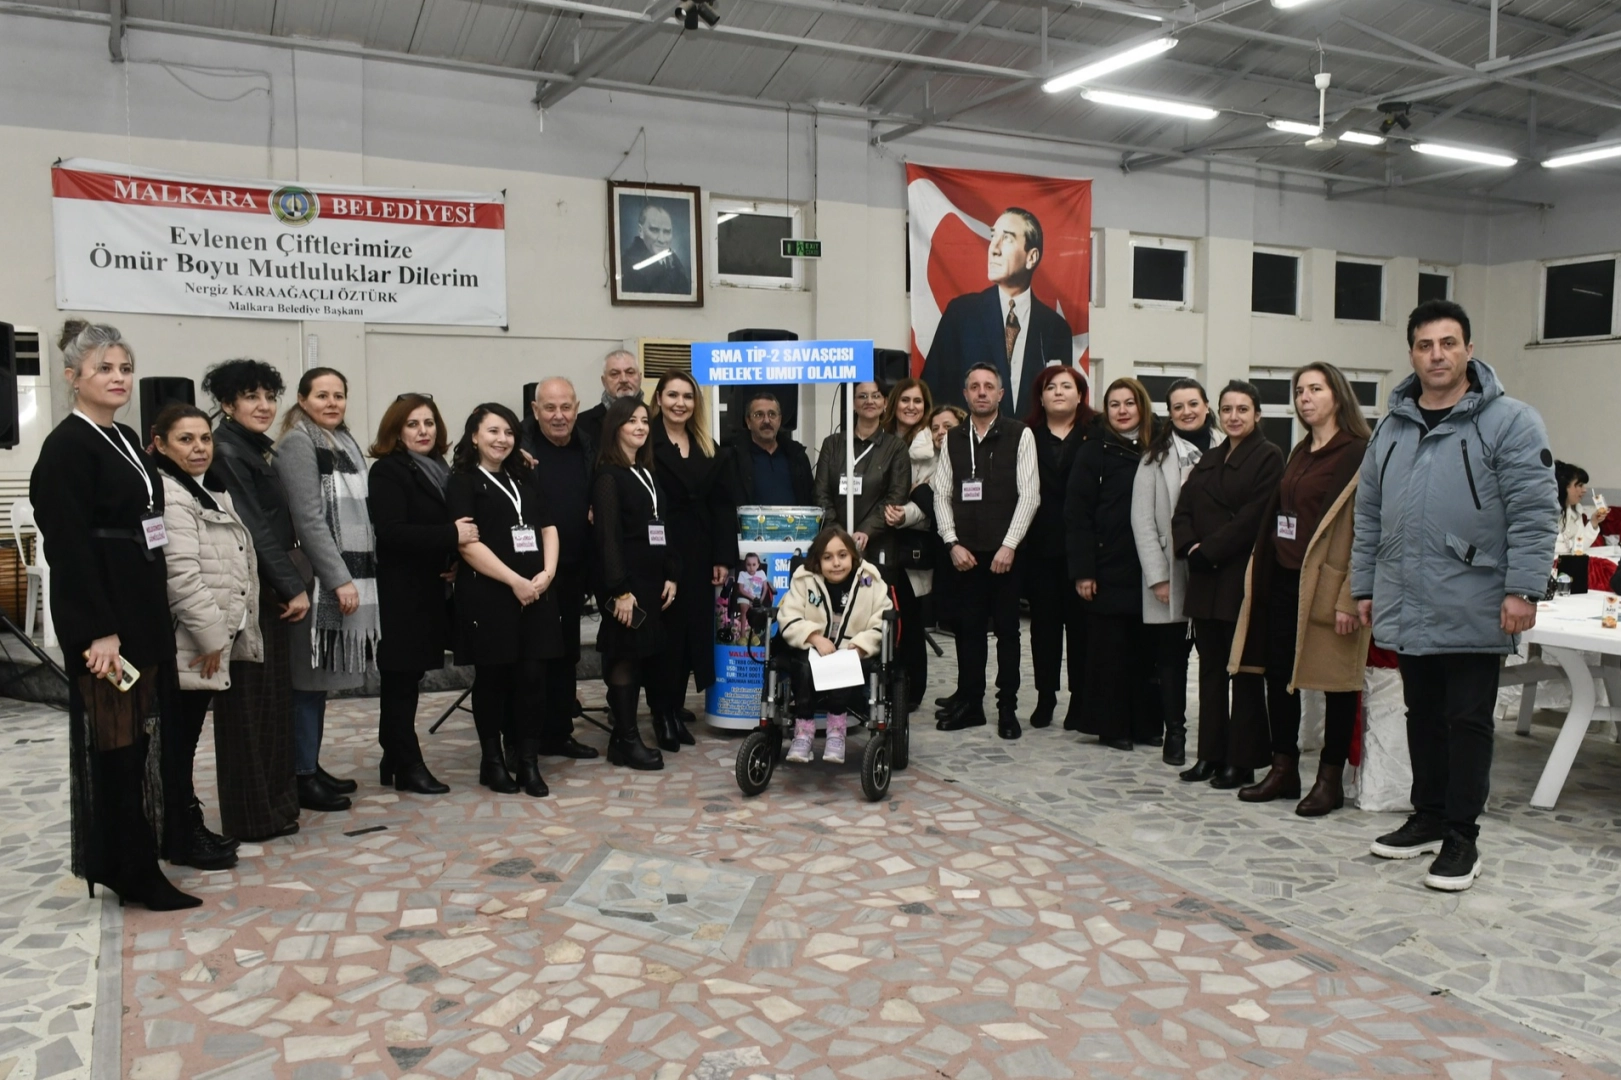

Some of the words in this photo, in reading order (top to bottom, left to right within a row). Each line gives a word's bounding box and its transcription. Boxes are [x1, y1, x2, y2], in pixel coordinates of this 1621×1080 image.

[113, 179, 257, 209] MALKARA
[332, 199, 476, 224] BELEDİYESİ
[170, 226, 268, 253] Evlenen
[276, 232, 413, 259] Çiftlerimize
[89, 242, 168, 274] Ömür
[177, 252, 239, 279] Boyu
[248, 258, 391, 284] Mutluluklar
[398, 264, 478, 288] Dilerim
[185, 281, 228, 297] Nergiz
[232, 283, 334, 301] KARAAĞAÇLI
[338, 286, 398, 303] ÖZTÜRK
[228, 300, 274, 313] Malkara
[277, 303, 320, 316] Belediye
[323, 306, 363, 317] Başkanı
[712, 349, 742, 363] SMA
[746, 346, 779, 362] TİP-2
[784, 348, 853, 363] SAVAŞÇISI
[710, 367, 762, 380] MELEK'E
[766, 367, 803, 380] UMUT
[808, 366, 856, 379] OLALIM
